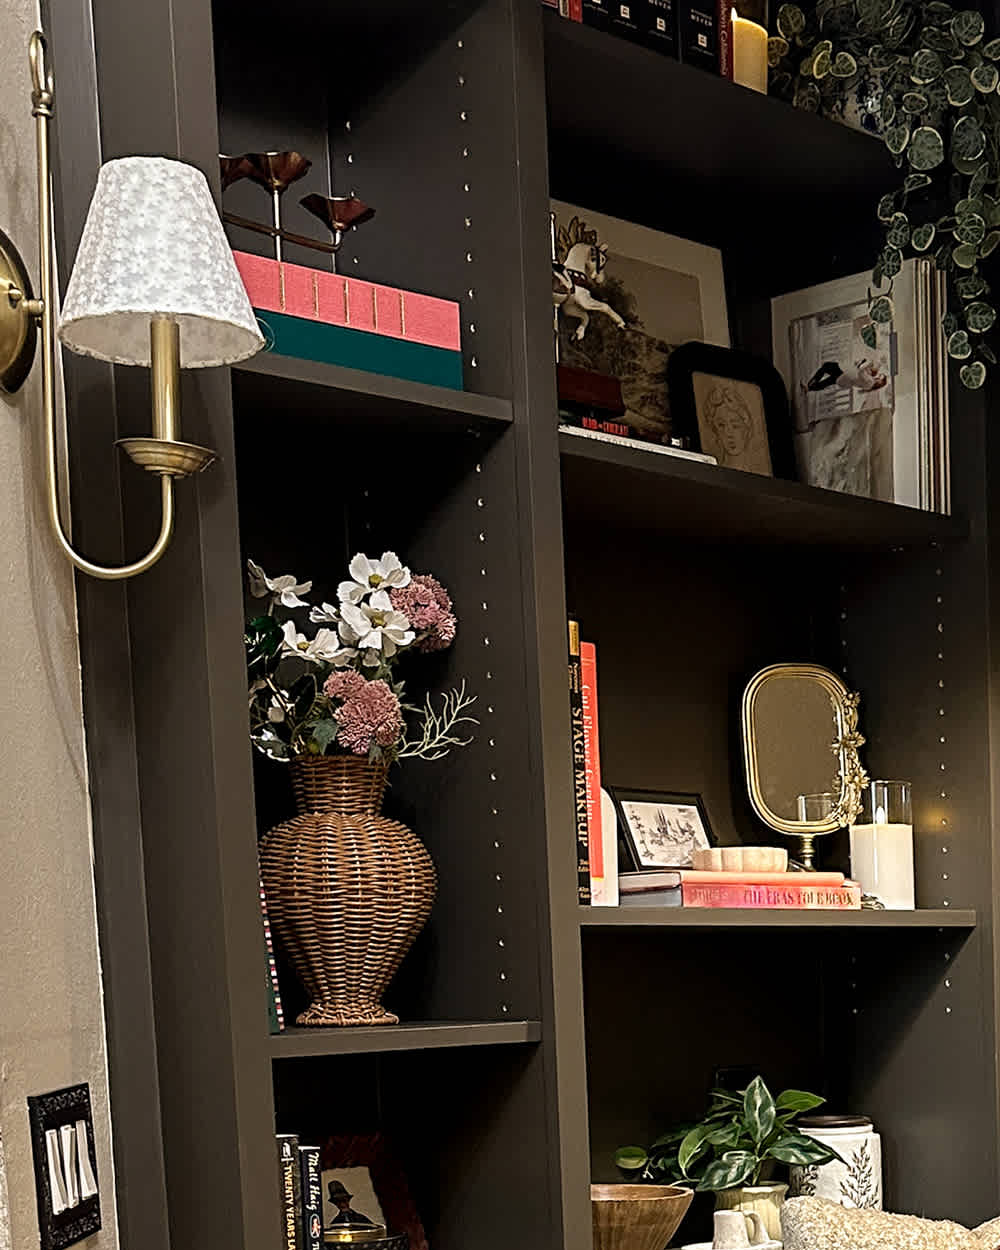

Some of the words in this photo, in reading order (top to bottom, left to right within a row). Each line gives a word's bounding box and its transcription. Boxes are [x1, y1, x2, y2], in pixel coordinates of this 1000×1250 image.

[572, 707, 584, 763] STAGE
[575, 769, 588, 847] MAKEUP
[308, 1151, 320, 1182] Matt
[284, 1165, 294, 1205] TWENTY
[306, 1184, 320, 1211] Haig
[286, 1206, 296, 1238] YEARS
